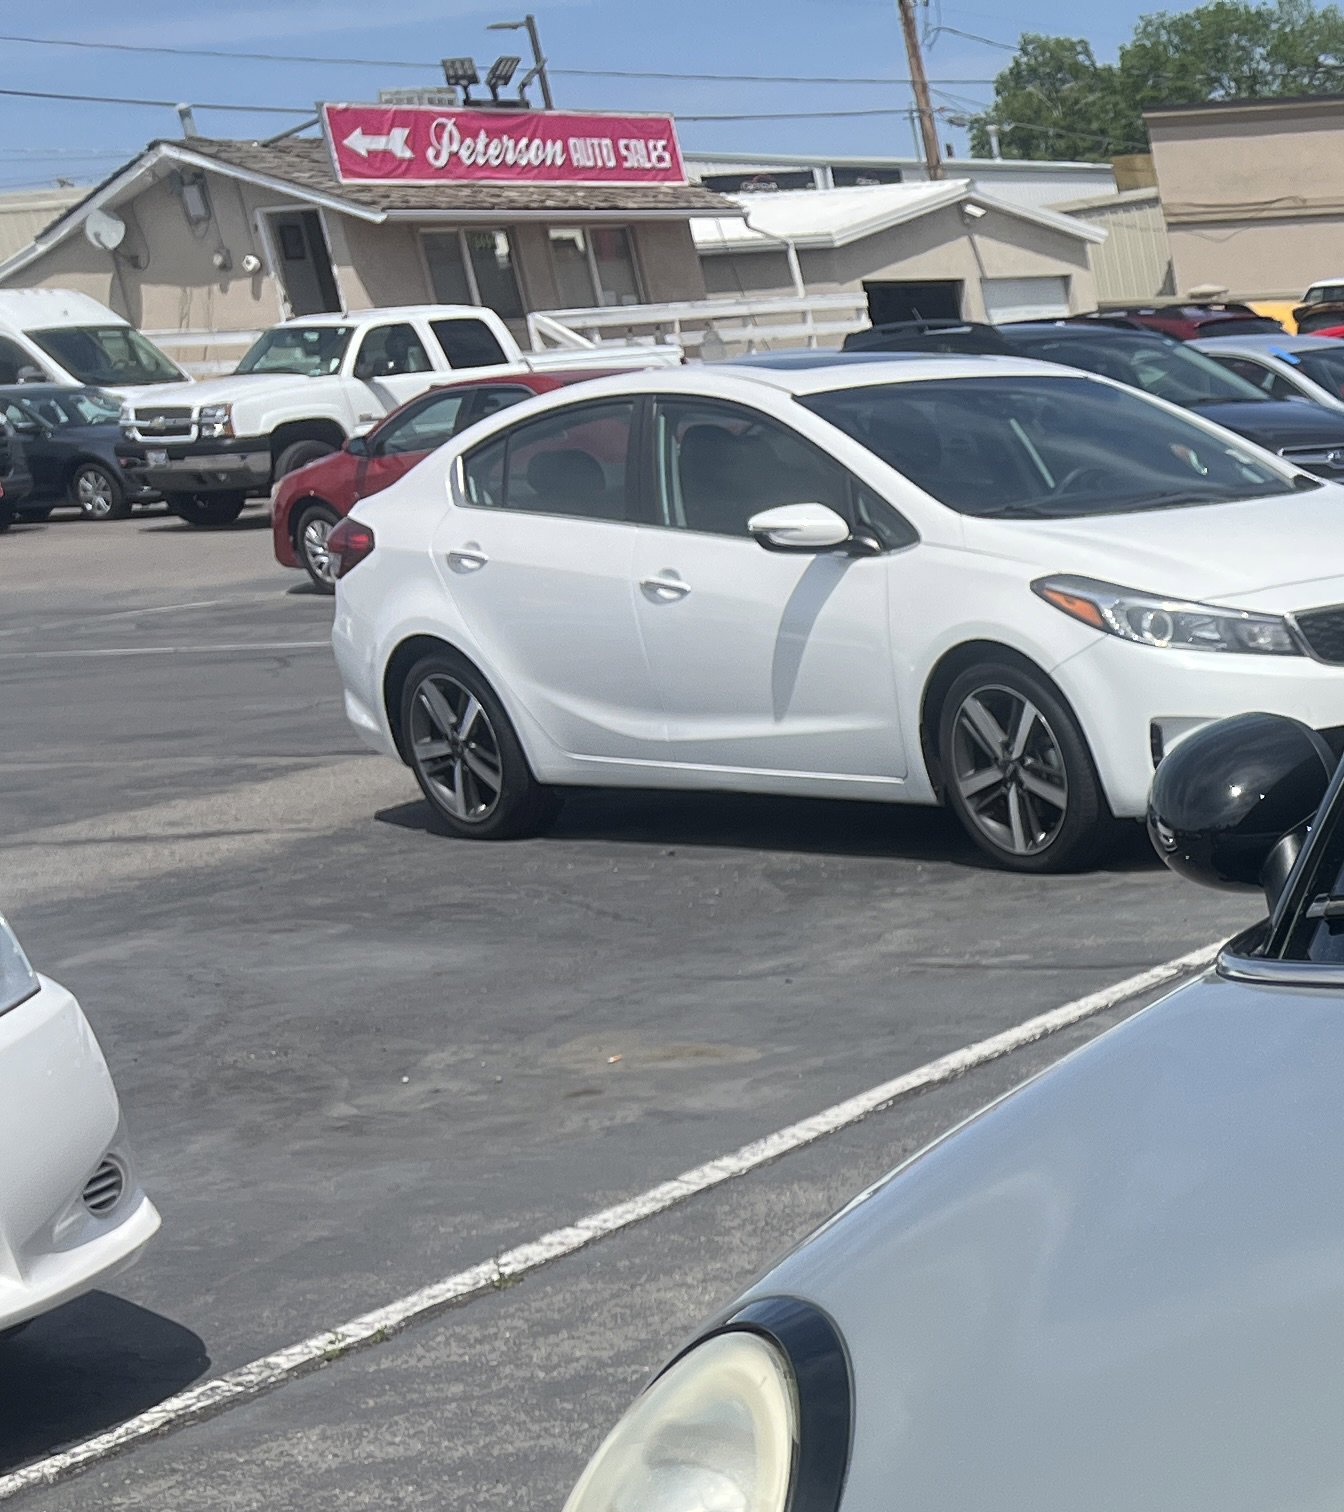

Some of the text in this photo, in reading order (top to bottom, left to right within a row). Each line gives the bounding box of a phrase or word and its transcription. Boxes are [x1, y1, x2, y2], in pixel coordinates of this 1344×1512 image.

[427, 117, 672, 169] Peterson AUTO SALES
